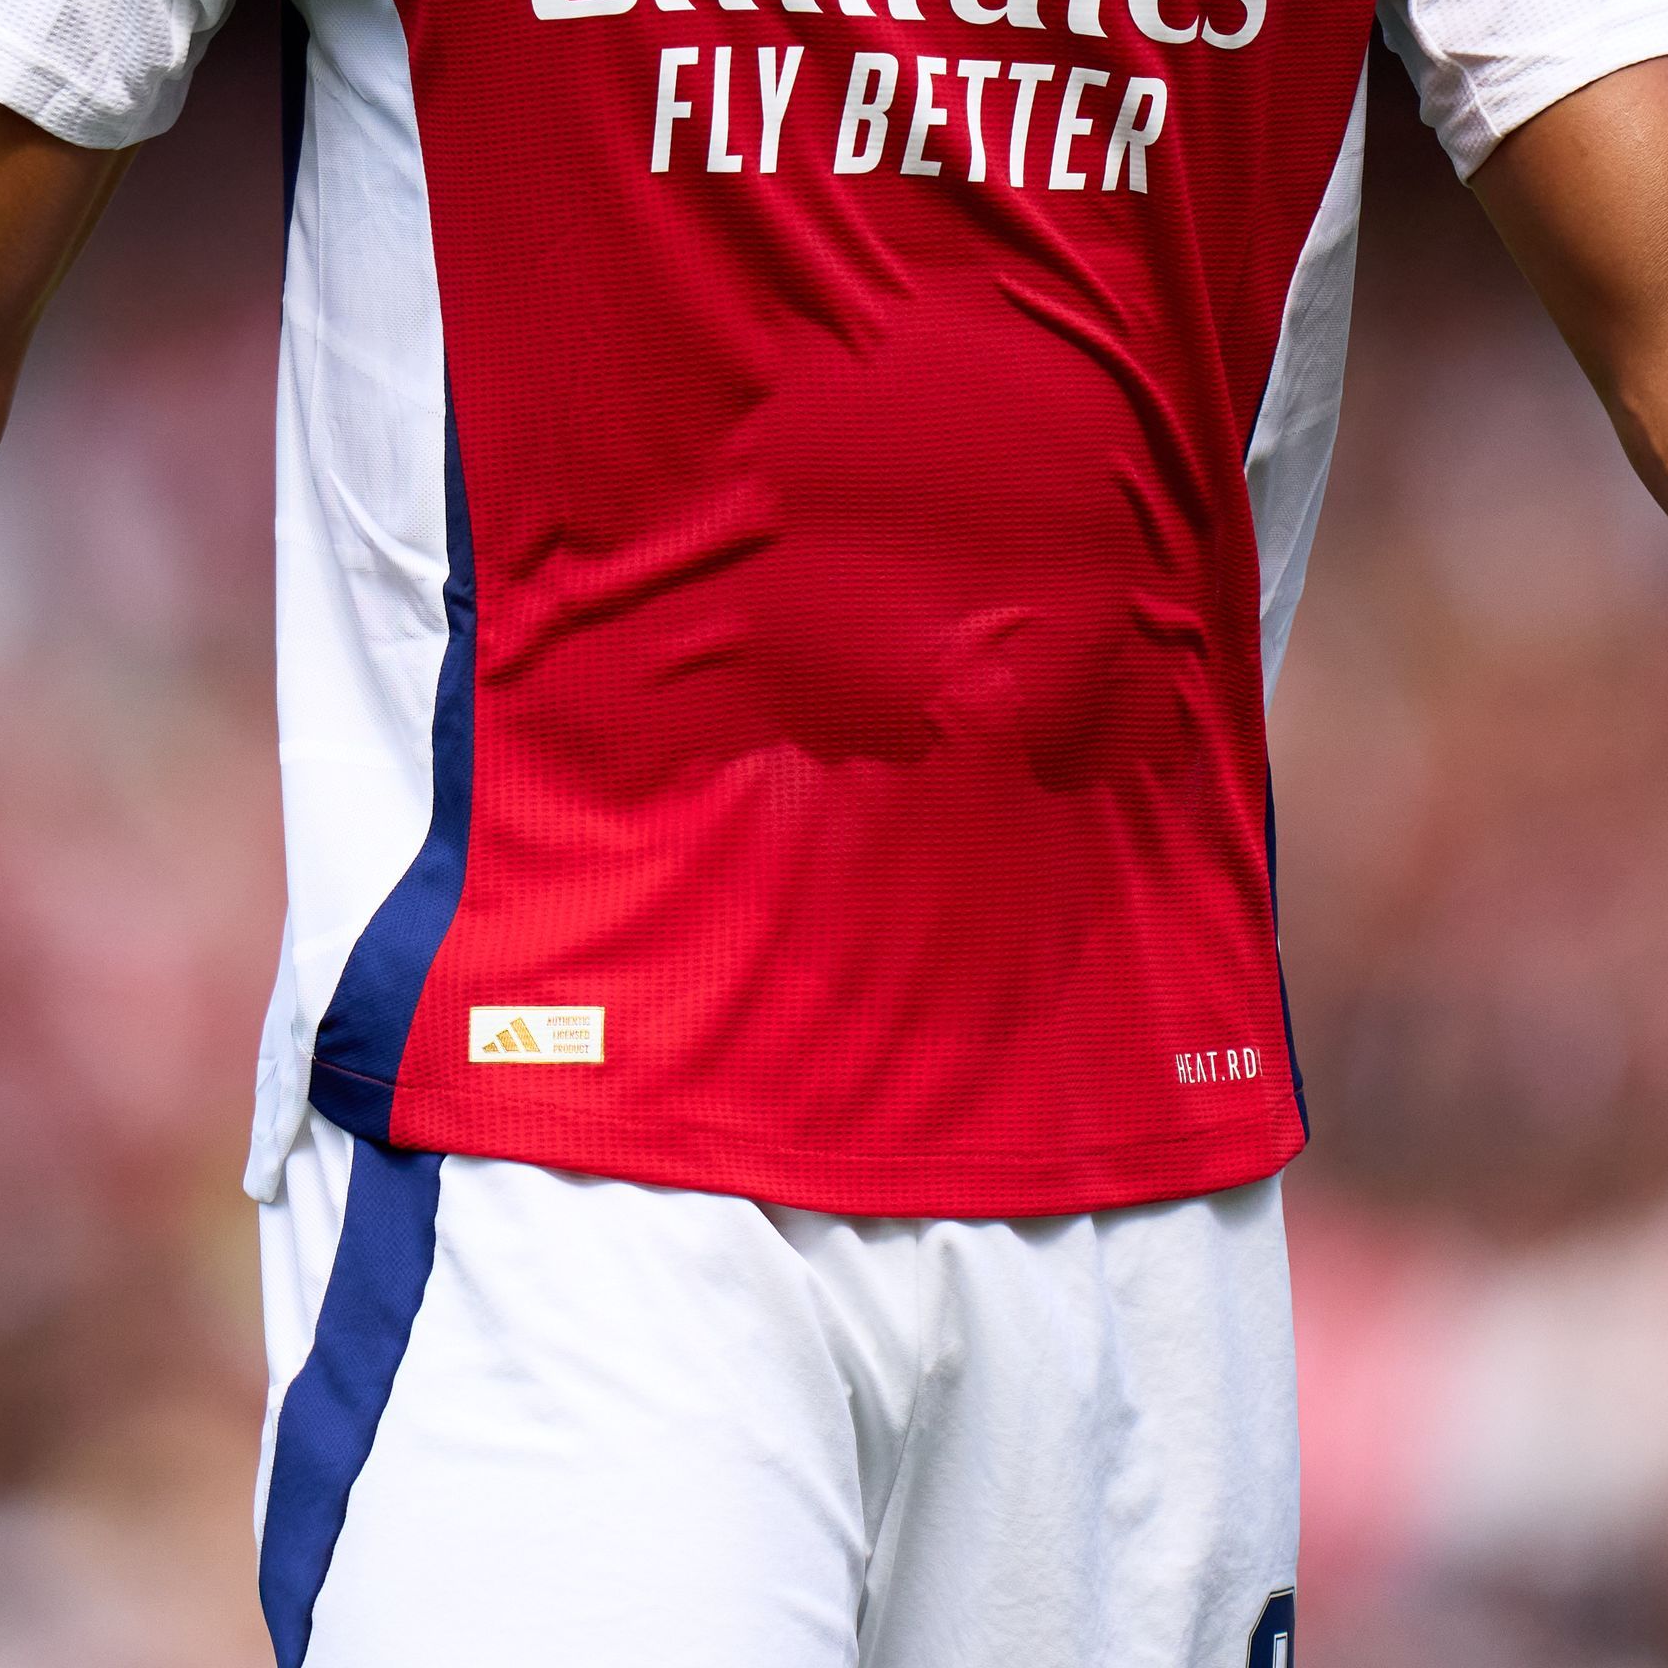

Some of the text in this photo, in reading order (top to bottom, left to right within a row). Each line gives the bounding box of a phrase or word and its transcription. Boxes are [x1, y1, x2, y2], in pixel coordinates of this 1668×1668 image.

[650, 46, 1167, 195] FLY BETTER
[546, 1015, 590, 1026] AUTHENTIC
[552, 1029, 590, 1039] LICENSED
[552, 1043, 589, 1054] PRODUCT
[1175, 1047, 1263, 1084] HEAT.RD
